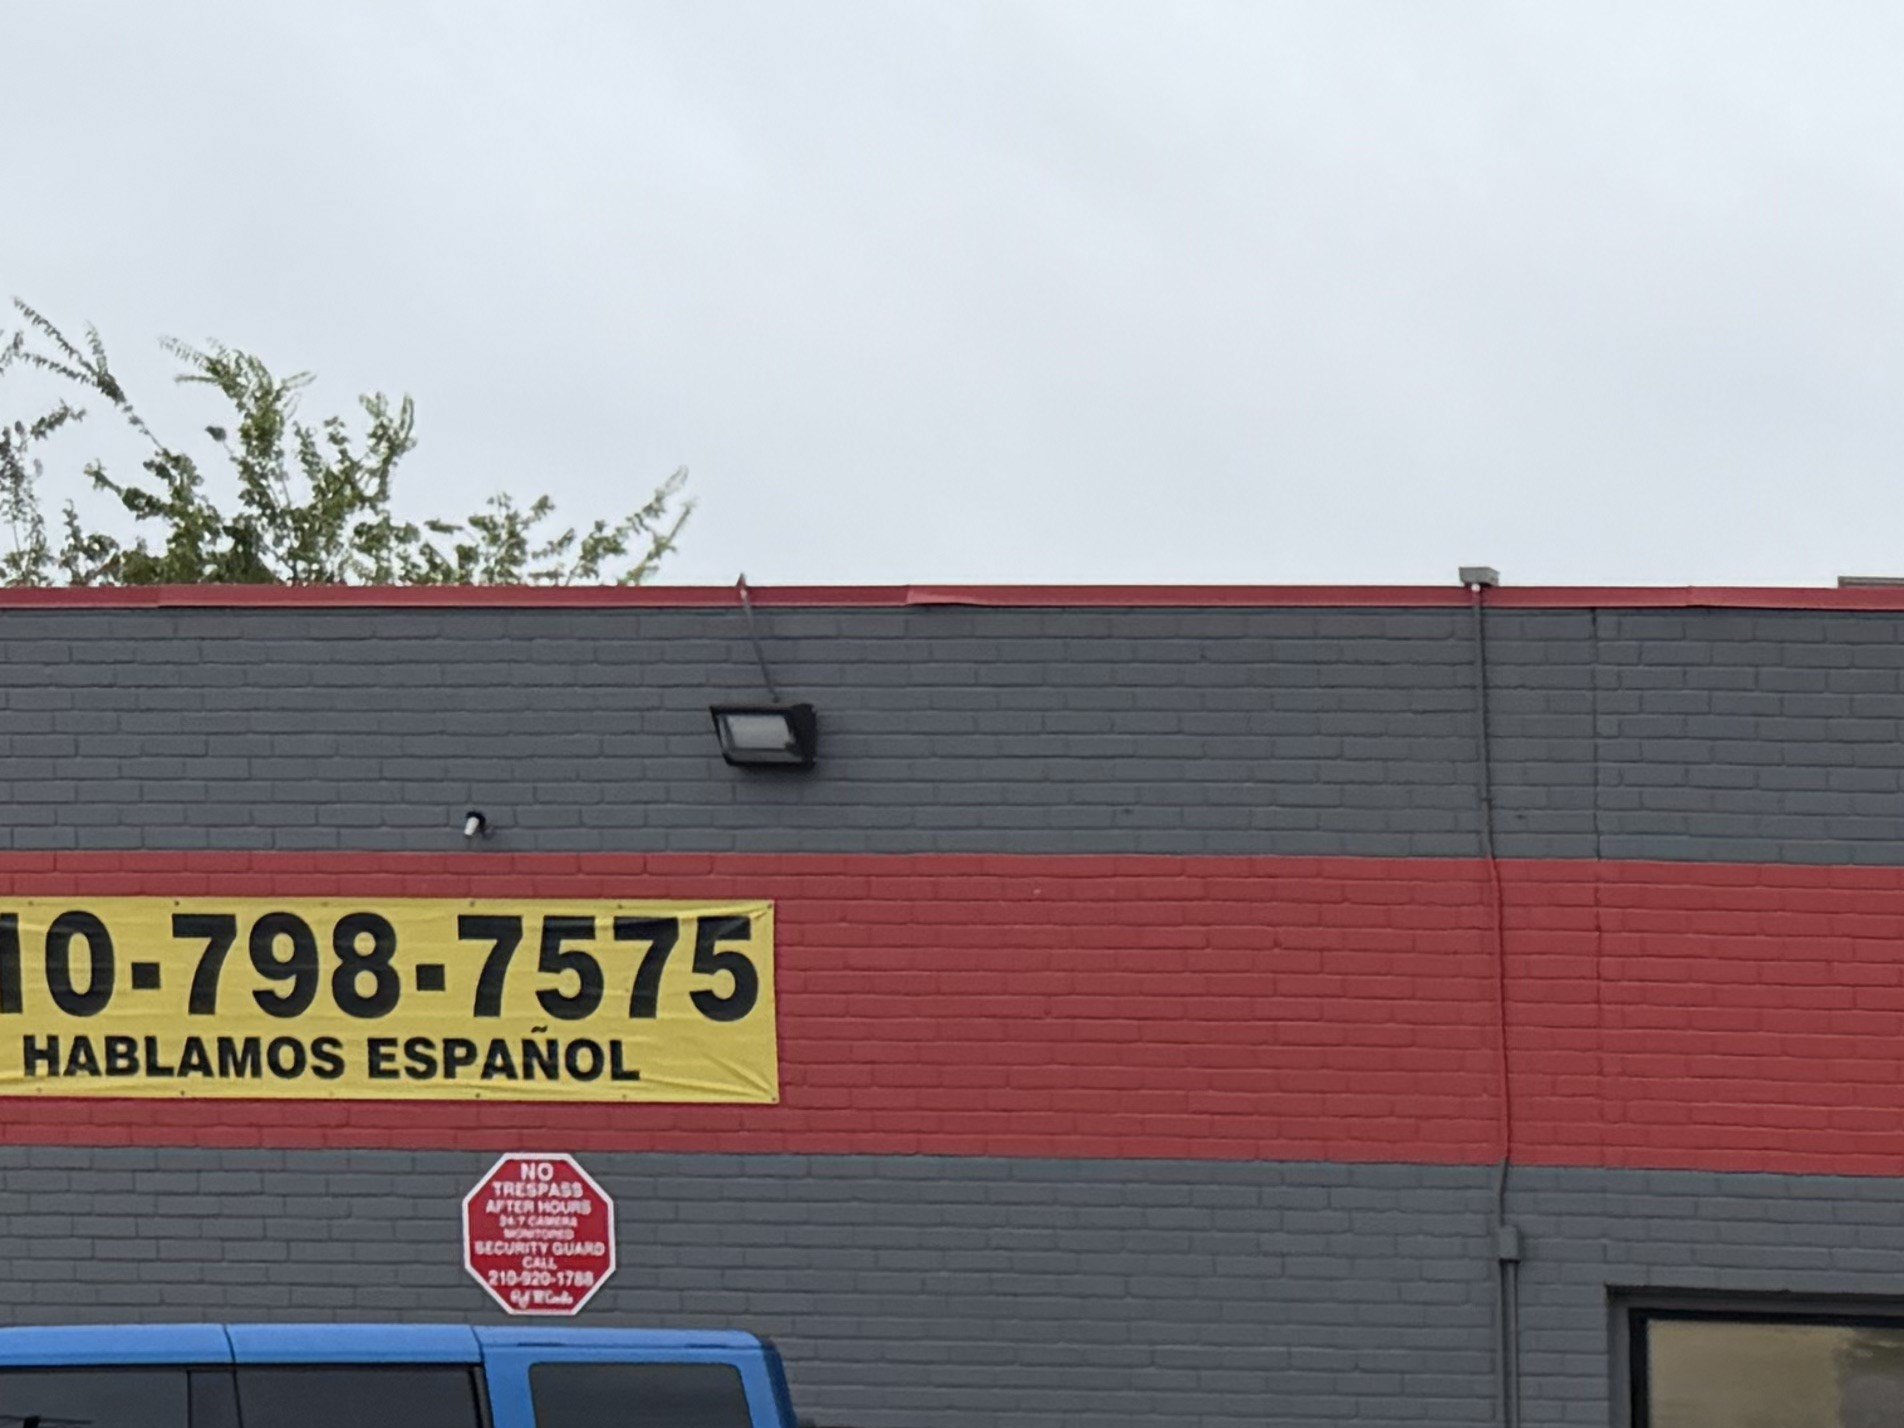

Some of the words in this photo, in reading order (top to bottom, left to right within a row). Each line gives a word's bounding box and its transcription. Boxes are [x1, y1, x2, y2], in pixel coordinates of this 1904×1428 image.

[22, 1033, 346, 1082] HABLAMOS
[367, 1025, 641, 1082] ESPAÑOL
[520, 1162, 554, 1181] NO
[492, 1181, 584, 1199] TRESPASS
[485, 1199, 535, 1214] AFTER
[537, 1199, 592, 1215] HOURS
[474, 1241, 550, 1256] SECURITY
[552, 1241, 606, 1256] GUARD
[521, 1256, 558, 1270] CALL
